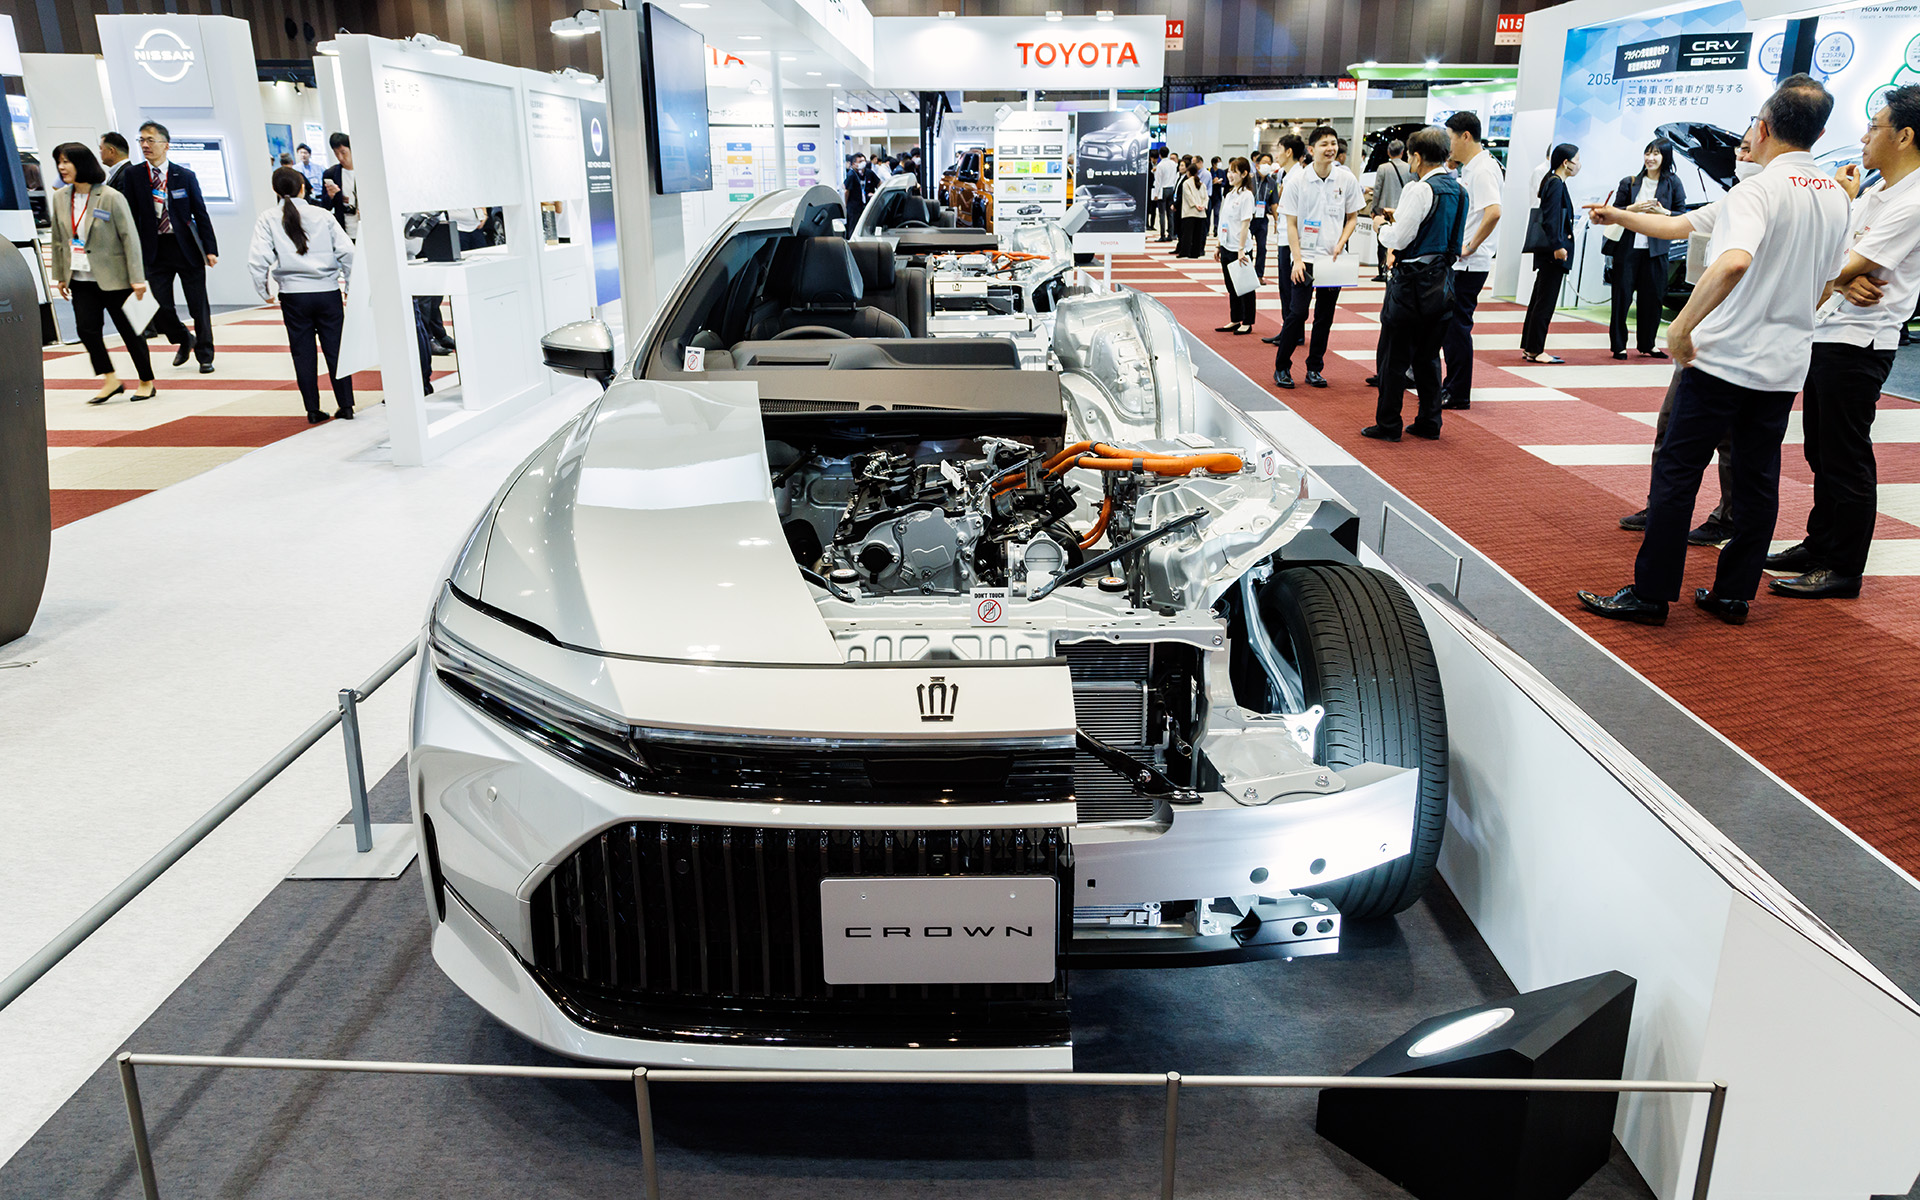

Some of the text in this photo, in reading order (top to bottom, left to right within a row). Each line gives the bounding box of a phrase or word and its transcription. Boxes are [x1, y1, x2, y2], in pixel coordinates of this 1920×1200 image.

[1168, 24, 1182, 35] 14
[1499, 18, 1523, 30] N15
[1692, 40, 1739, 51] CR-V
[134, 50, 195, 61] NISSAN
[1016, 42, 1139, 66] TOYOTA
[1626, 84, 1744, 95] 二輪車、四輪車が関与する
[1626, 96, 1709, 107] 交通事故死者ゼロ
[845, 926, 1033, 938] CROWN
